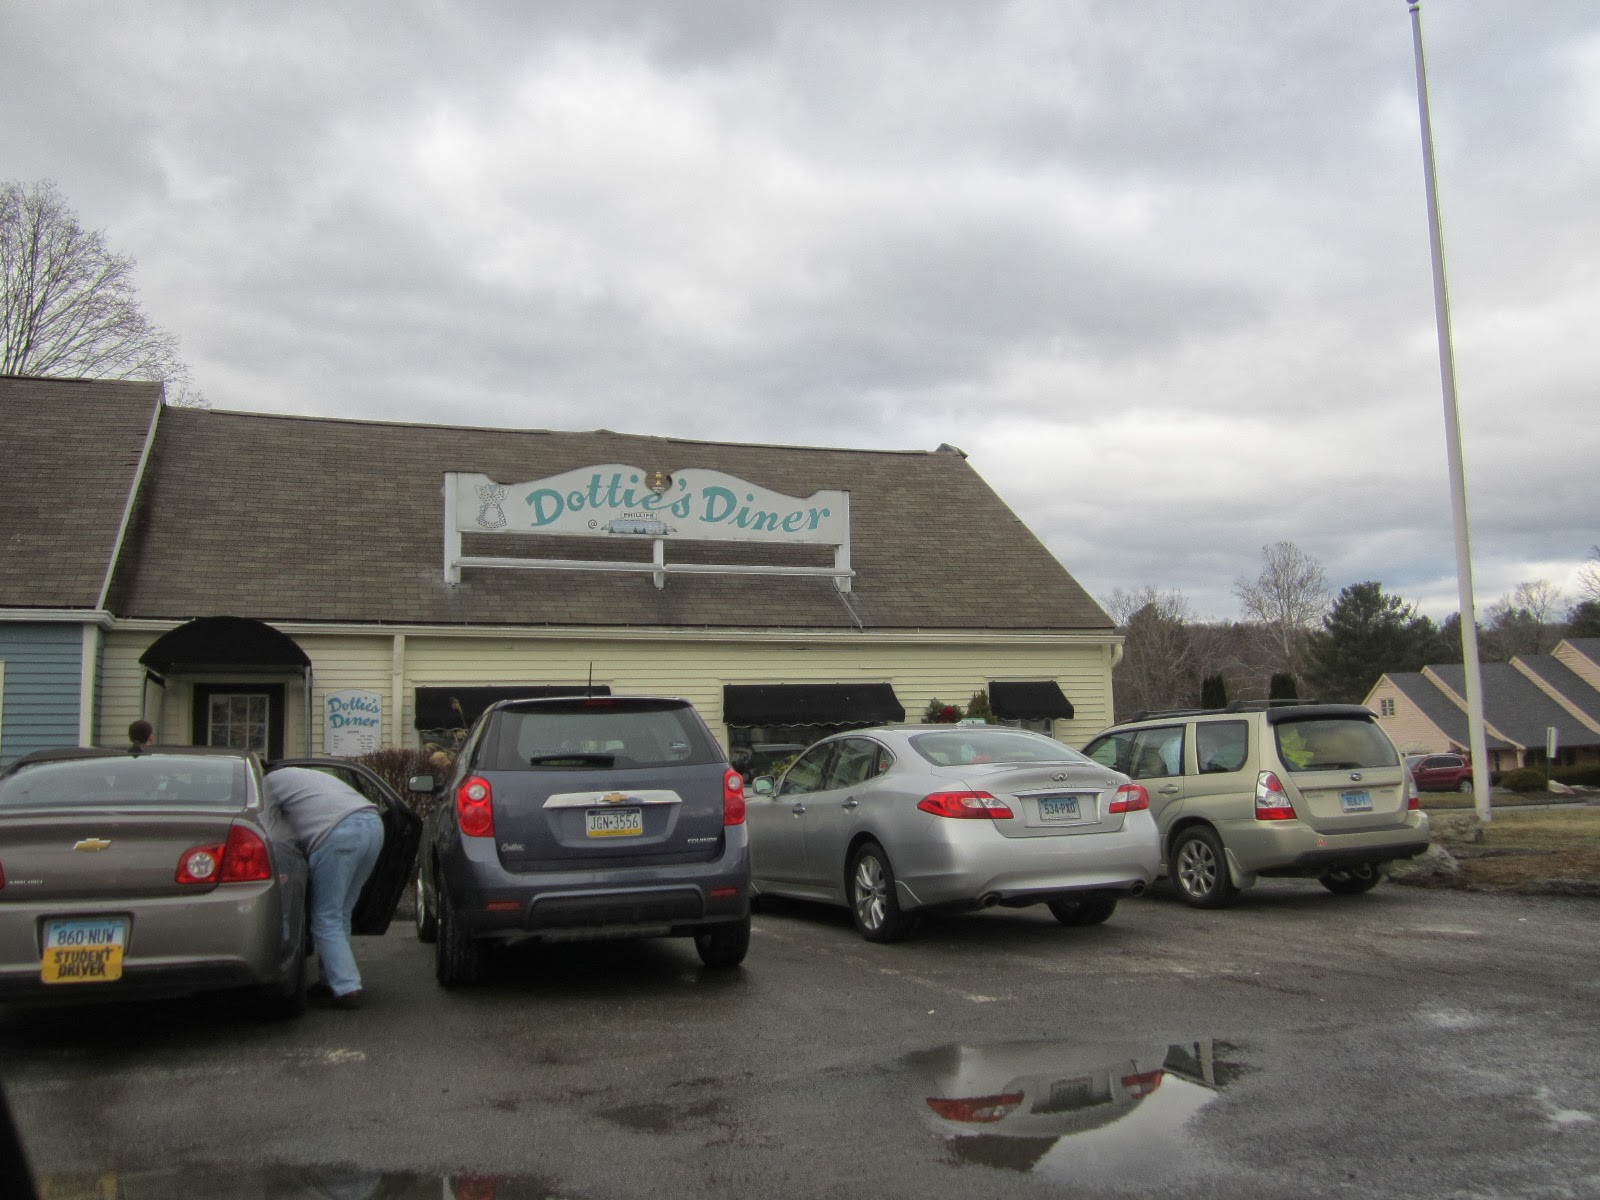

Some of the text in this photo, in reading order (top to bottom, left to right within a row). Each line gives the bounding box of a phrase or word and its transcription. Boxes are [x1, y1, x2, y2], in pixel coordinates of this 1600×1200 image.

[525, 473, 832, 534] Dottie's Diner
[327, 696, 381, 713] Dottie's
[329, 711, 380, 729] Diner
[54, 946, 113, 963] STUDENT
[57, 961, 107, 978] DRIVER
